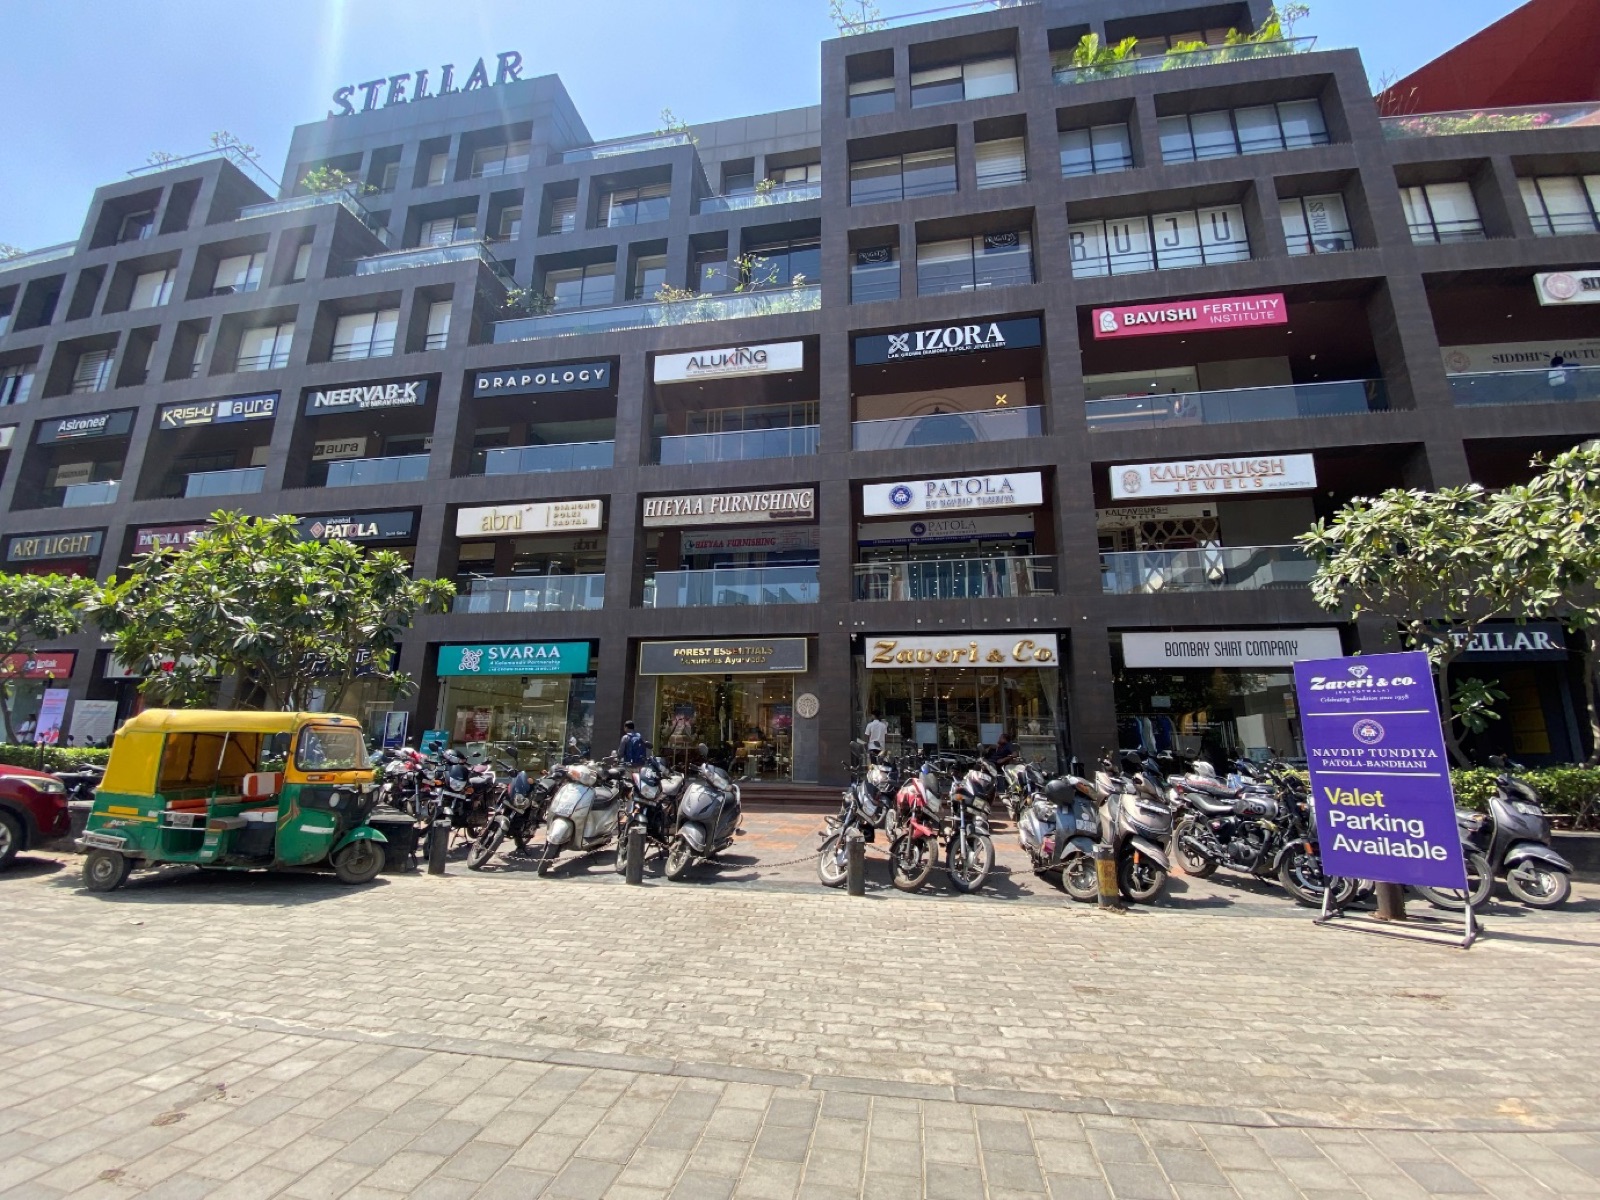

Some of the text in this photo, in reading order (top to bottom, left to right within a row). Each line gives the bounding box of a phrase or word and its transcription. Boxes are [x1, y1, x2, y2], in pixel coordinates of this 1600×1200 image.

[327, 51, 523, 119] STELLAR
[1123, 298, 1279, 326] BAVISHI FERTILITY
[1209, 311, 1276, 324] INSTITUTE
[915, 323, 1006, 351] IZORA
[686, 348, 768, 370] ALUKING
[1491, 350, 1551, 364] SIDDHI'S
[478, 368, 605, 390] DRAPOLOGY
[314, 381, 420, 408] NEERVAB-K
[233, 398, 275, 415] aura
[58, 416, 106, 432] Astronea
[325, 442, 359, 454] aura
[1149, 459, 1286, 480] KALPAVRUKSH
[924, 478, 1014, 499] PATOLA
[1174, 478, 1264, 492] JEWELS
[553, 503, 597, 511] DIAMOND
[644, 491, 812, 517] HIEYAA FURNISHING
[1105, 506, 1169, 516] KALPAVRUKSH
[481, 509, 523, 532] abni
[928, 519, 977, 532] PATOLA
[324, 522, 379, 538] PATOLA
[14, 534, 93, 557] ART LIGHT
[695, 539, 724, 549] HIEYAA
[726, 537, 776, 547] FURNISHING
[1164, 640, 1299, 657] BOMBAY SHIRT COMPANY
[1450, 630, 1553, 651] TELLAR
[488, 645, 561, 660] SVARAA
[673, 646, 774, 656] FOREST ESSENTIALS
[871, 639, 1057, 664] Zaveri & Co.
[1310, 675, 1374, 691] Zaveri
[1376, 677, 1389, 687] &
[1320, 695, 1351, 703] Celebrating
[1352, 694, 1378, 702] Tradition
[1312, 748, 1438, 758] NAVDIP TUNDIYA
[1322, 758, 1427, 769] PATOLA-BANDHANI
[1324, 786, 1386, 808] Valet
[1329, 809, 1425, 838] Parking
[1332, 833, 1448, 861] Available
